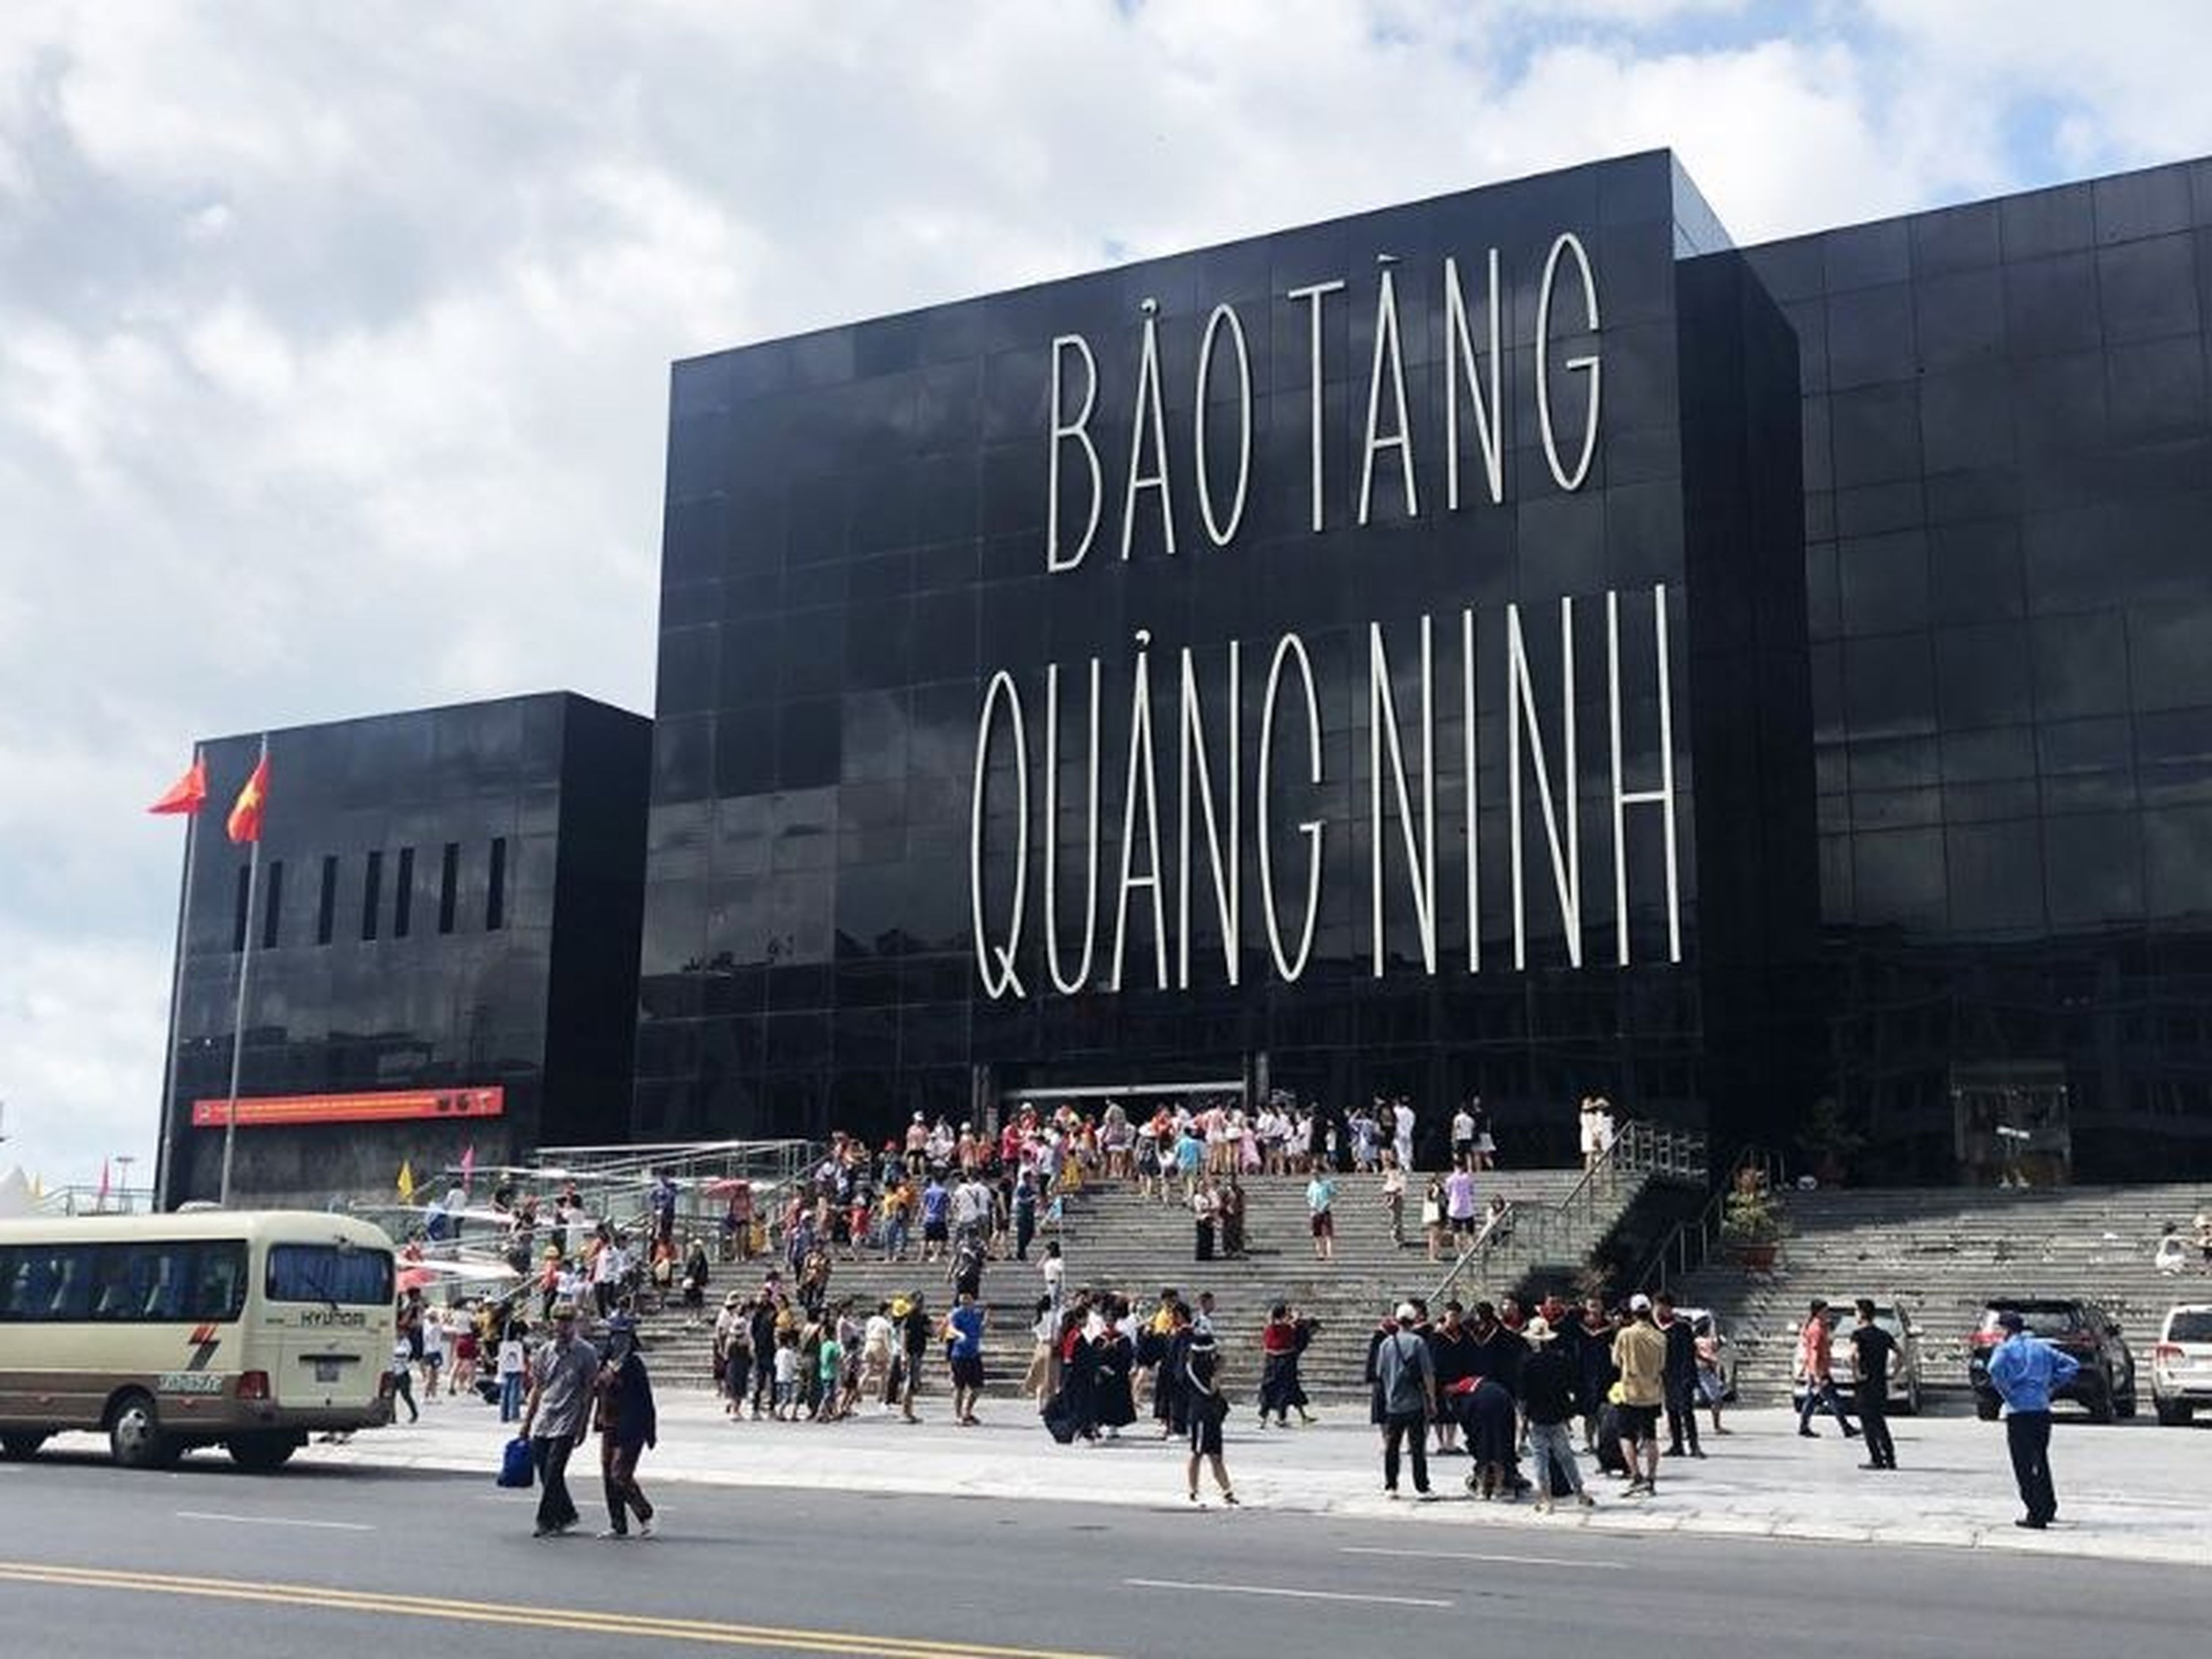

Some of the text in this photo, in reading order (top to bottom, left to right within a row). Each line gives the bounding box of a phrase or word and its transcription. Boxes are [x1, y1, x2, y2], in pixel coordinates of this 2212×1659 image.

[1048, 232, 1600, 573] BẢO TÀNG
[971, 584, 1681, 999] QUẢNG NINH
